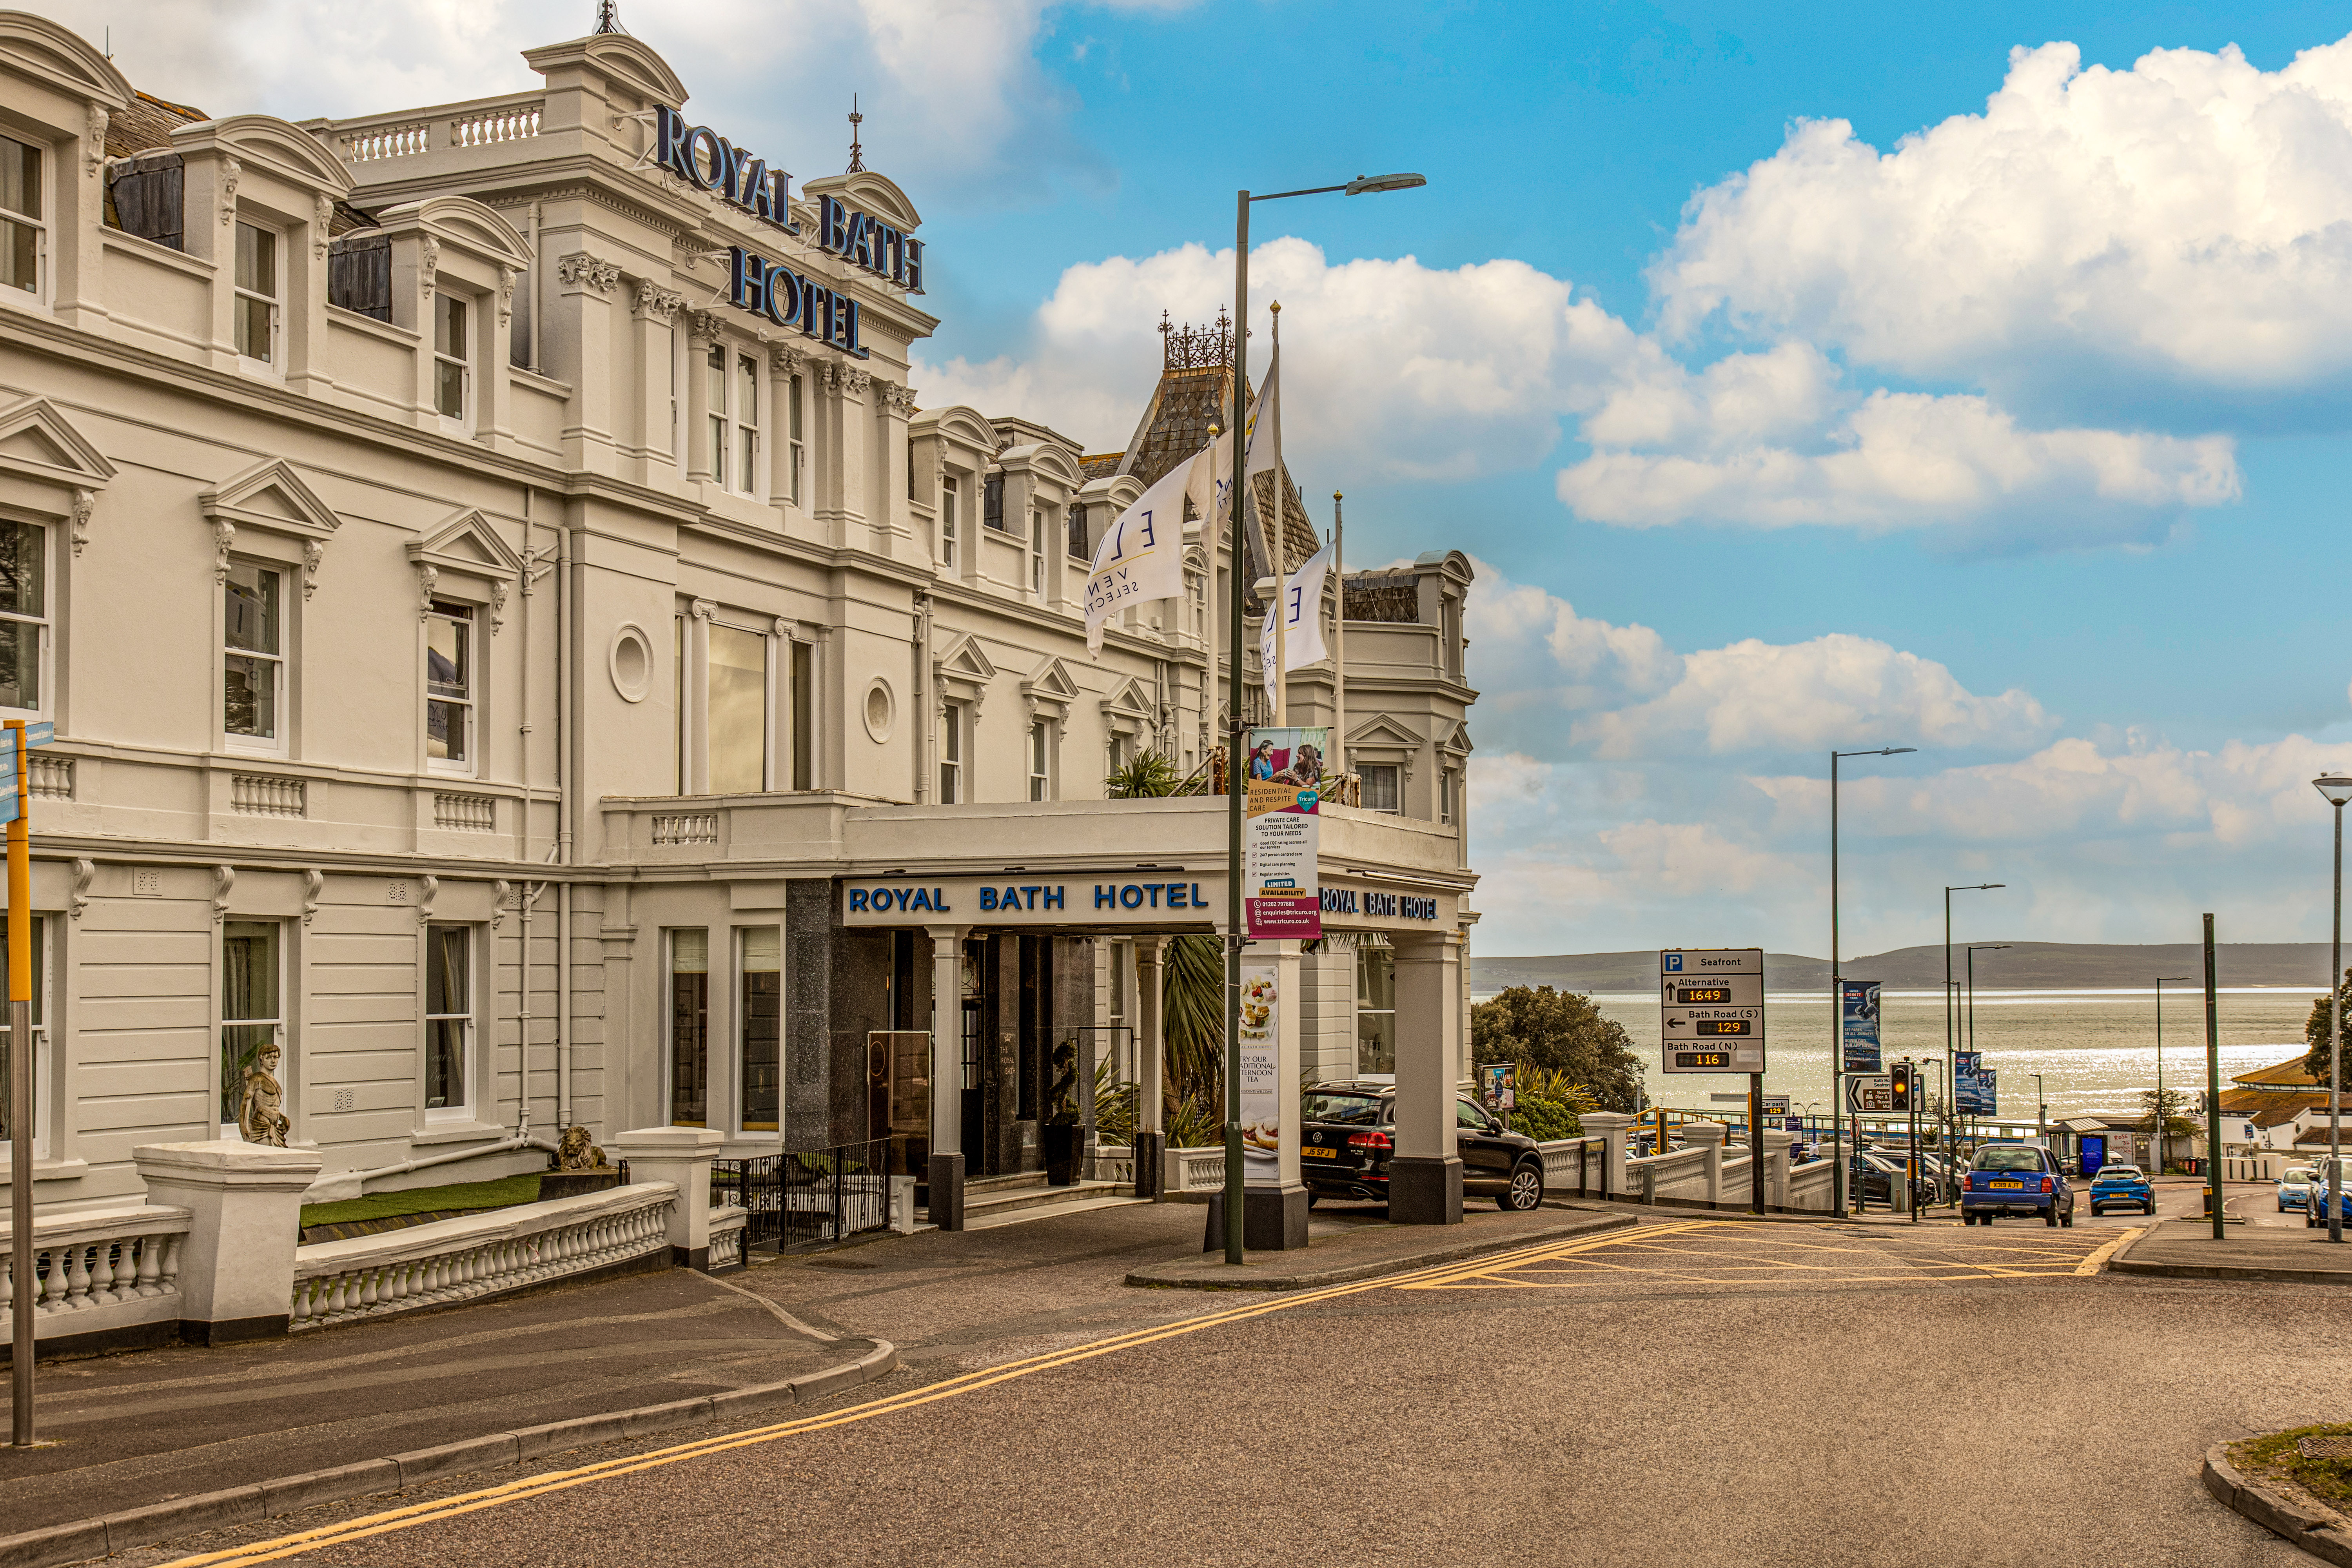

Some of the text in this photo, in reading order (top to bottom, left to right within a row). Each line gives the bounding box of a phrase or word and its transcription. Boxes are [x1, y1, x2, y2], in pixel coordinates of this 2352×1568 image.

[653, 104, 926, 295] ROYAL BATH
[726, 245, 869, 360] HOTEL
[849, 882, 1209, 911] ROYAL BATH HOTEL
[1319, 887, 1439, 919] ROYAL BATH HOTEL
[1670, 956, 1680, 970] P
[1690, 990, 1721, 1000] 1649
[1718, 1022, 1740, 1032] 129
[1697, 1054, 1719, 1065] 116
